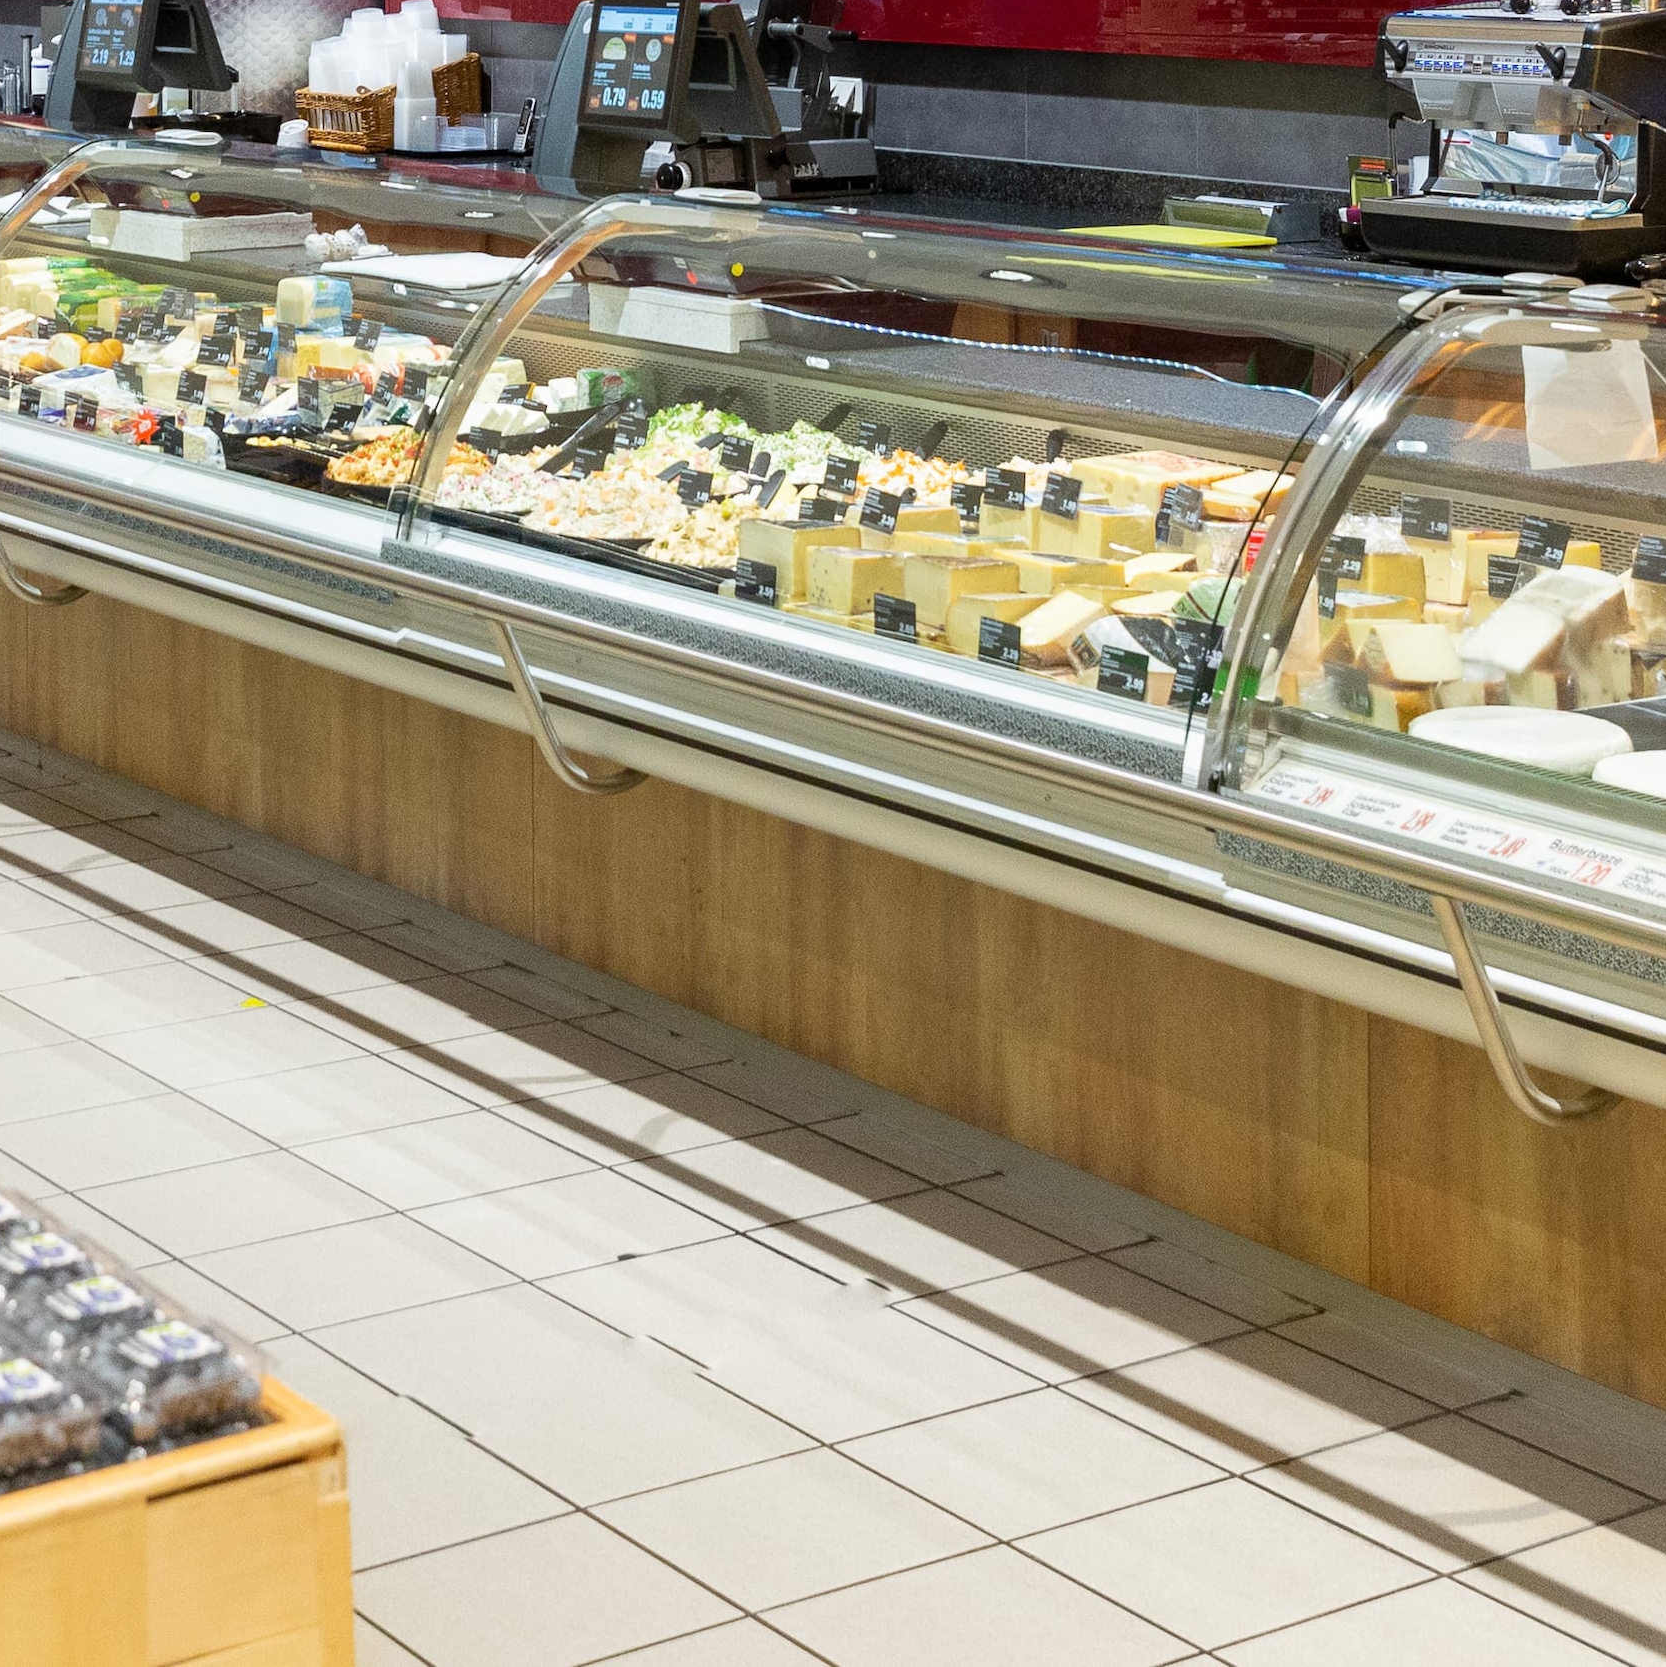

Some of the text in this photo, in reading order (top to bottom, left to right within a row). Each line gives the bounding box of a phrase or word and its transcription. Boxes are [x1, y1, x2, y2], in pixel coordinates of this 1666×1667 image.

[602, 86, 627, 107] 0.79
[640, 89, 666, 110] 0.59
[1430, 521, 1448, 535] 1.99
[1302, 785, 1334, 808] 2.99
[1399, 808, 1436, 834] 2.99
[1548, 838, 1624, 867] Butterbreze
[1571, 861, 1612, 886] 1.20
